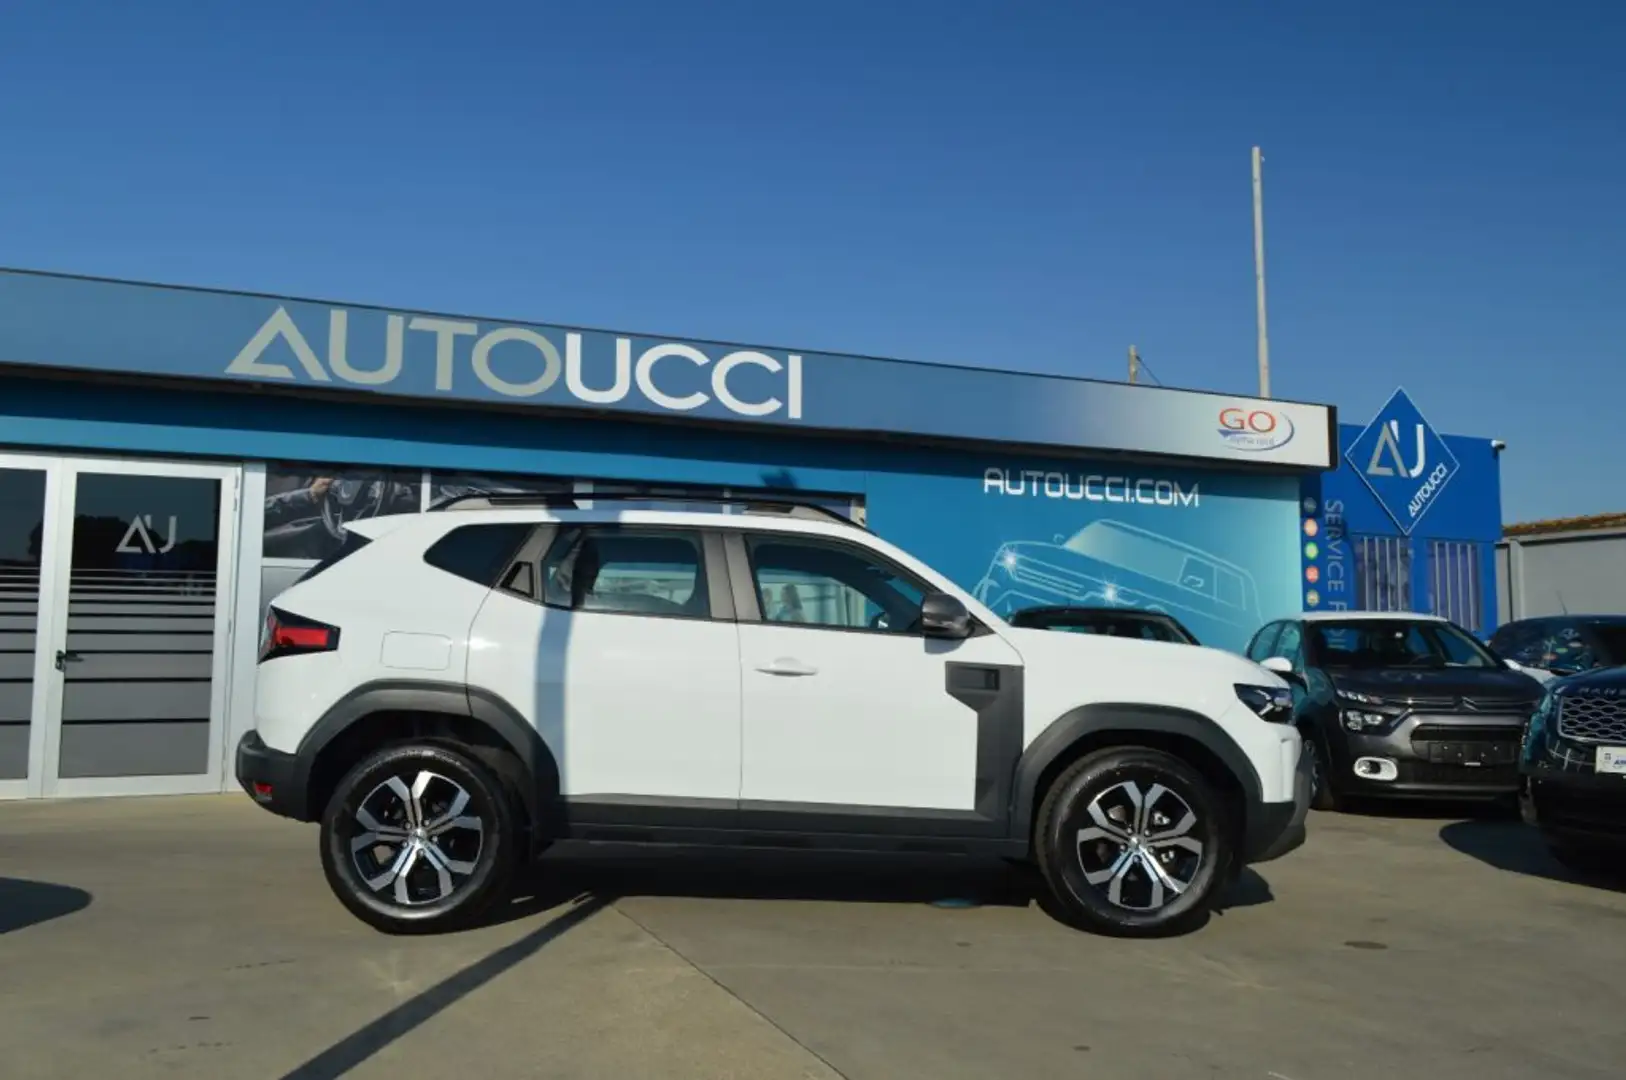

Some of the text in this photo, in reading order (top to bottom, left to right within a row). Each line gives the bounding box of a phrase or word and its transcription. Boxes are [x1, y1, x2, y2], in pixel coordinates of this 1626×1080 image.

[224, 305, 803, 419] AUTOUCCI
[1218, 407, 1277, 433] GO
[983, 467, 1200, 509] AUTOUCCI.COM
[1408, 462, 1448, 518] AUTOUCCI
[1324, 499, 1345, 593] SERVICE
